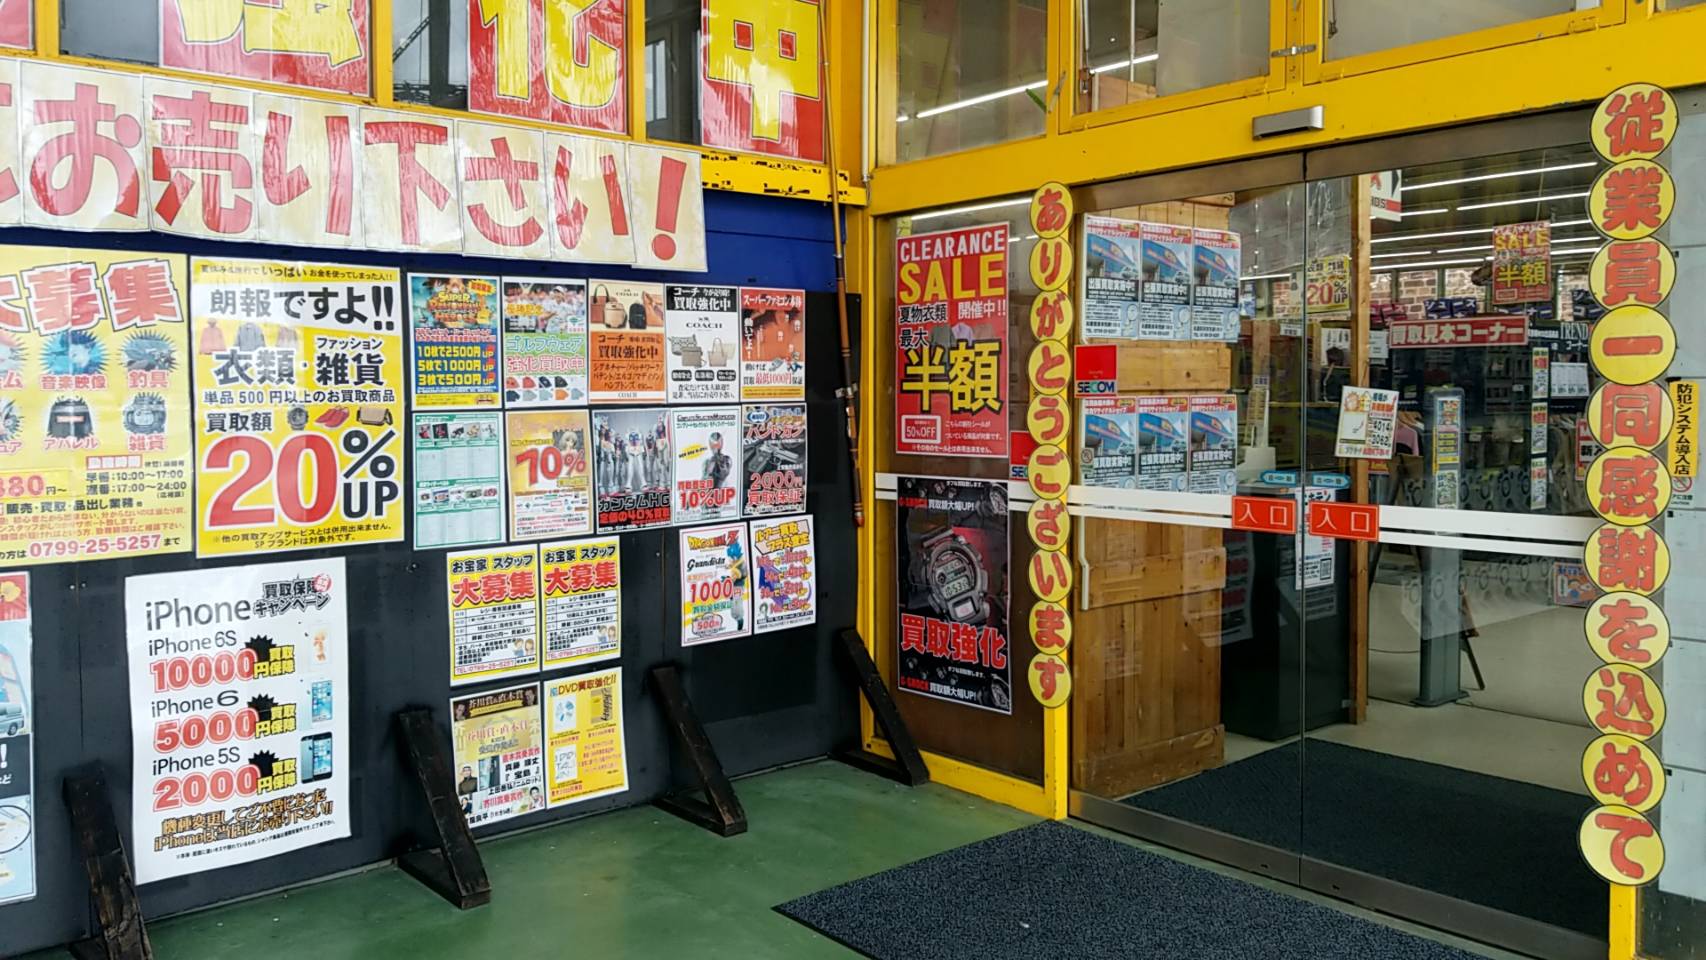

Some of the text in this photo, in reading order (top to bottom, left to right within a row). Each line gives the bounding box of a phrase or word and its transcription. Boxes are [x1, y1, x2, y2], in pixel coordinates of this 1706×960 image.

[0, 83, 687, 261] お売り下さい!
[1371, 196, 1386, 209] IDS
[900, 229, 1005, 263] CLEARANCE
[1494, 231, 1549, 250] SALE
[262, 266, 307, 279] いっぱい
[899, 253, 1004, 304] SALE
[1496, 261, 1547, 287] 半額
[673, 288, 700, 297] コーチ
[673, 296, 732, 312] 買取強化中
[1334, 293, 1348, 304] UP
[210, 285, 394, 331] 朗報ですよ!!
[899, 299, 1006, 324] 夏物衣類 開催中!!
[316, 337, 383, 350] ファッション
[598, 334, 624, 343] コーチ
[900, 327, 930, 349] 最大
[1392, 323, 1524, 345] 買取見本コーナー
[598, 346, 659, 359] 買取強化中
[41, 375, 107, 390] 音楽映像
[129, 370, 169, 389] 釣具
[213, 351, 385, 386] 衣類・雑貨
[902, 340, 1003, 414] 半額
[204, 389, 395, 405] 単品 500 円以上のお買取商品
[1077, 381, 1115, 393] SECOM
[206, 412, 272, 433] 買取額
[906, 426, 936, 438] 50%OFF
[1674, 383, 1693, 475] 防犯システム導入店
[0, 441, 22, 454] ュア
[129, 434, 166, 451] 雑貨
[1034, 188, 1068, 700] ありがとうございます
[515, 447, 587, 486] 10%
[1594, 90, 1666, 879] 従業員一同感謝を込めて
[343, 480, 399, 519] UP
[1238, 502, 1288, 526] 入口
[1315, 508, 1370, 533] 入口
[30, 534, 162, 558] 0799-25-5257
[163, 537, 181, 547] まで
[545, 546, 616, 563] お宝家 スタッフ
[452, 554, 533, 573] お宝家 スタッフ
[452, 571, 535, 606] 大募集
[545, 561, 617, 595] 大募集
[690, 579, 734, 603] 1000
[145, 598, 251, 632] iPhone
[149, 630, 238, 657] iPhone 6S
[901, 612, 1007, 670] 買取強化
[152, 649, 256, 692] 10000
[151, 690, 240, 718] iPhone 6
[155, 711, 258, 752] 5000
[152, 747, 241, 776] iPhone 5S
[154, 765, 261, 811] 2000
